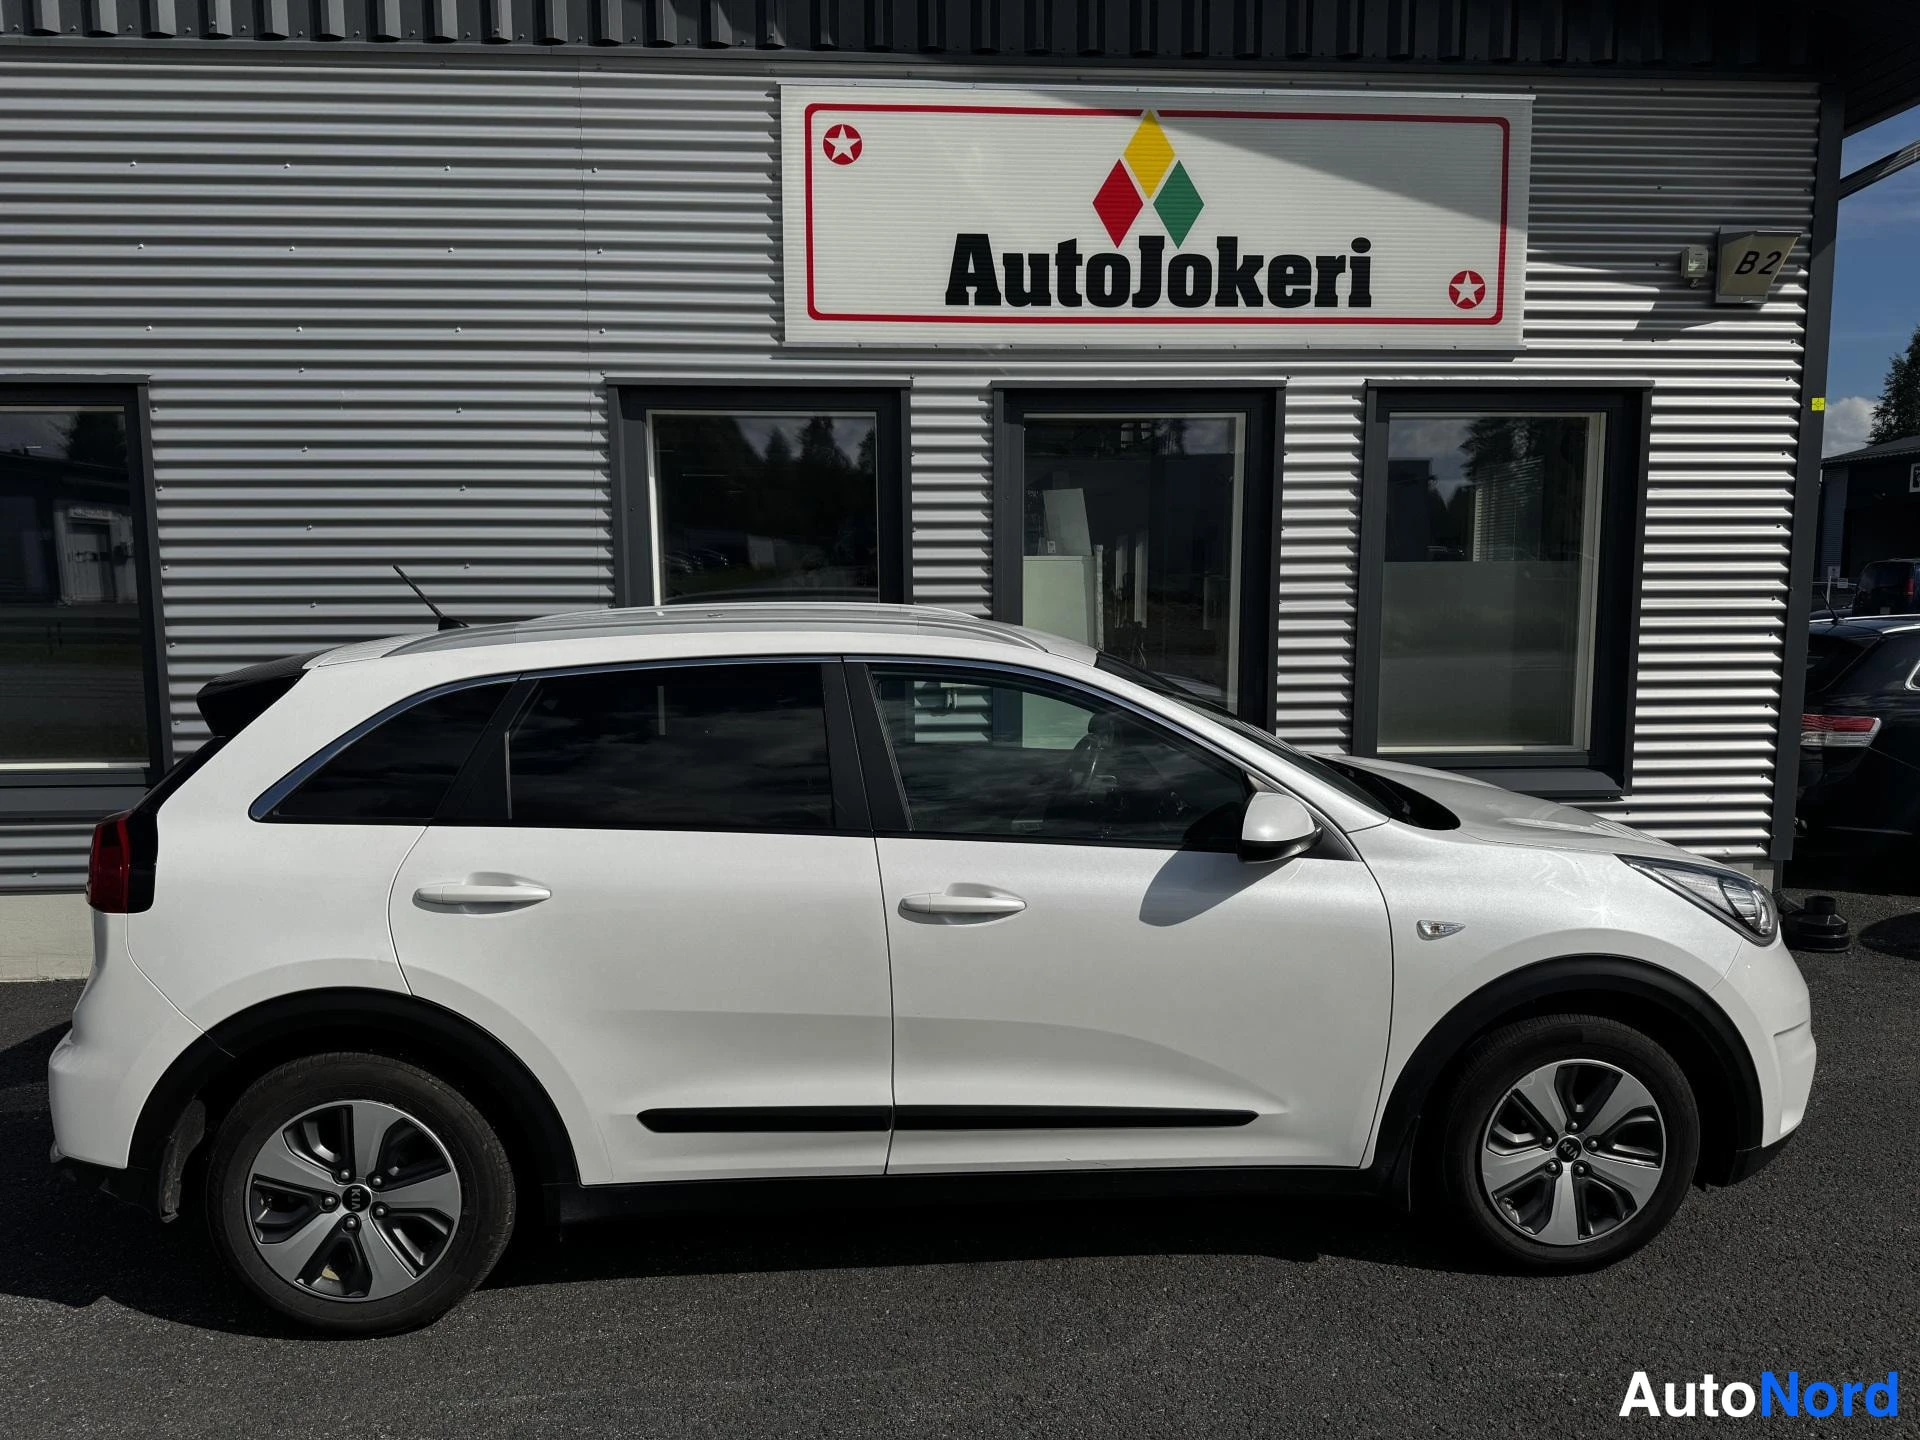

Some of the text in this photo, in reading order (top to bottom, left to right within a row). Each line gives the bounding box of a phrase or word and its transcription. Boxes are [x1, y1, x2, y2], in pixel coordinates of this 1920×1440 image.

[945, 233, 1372, 308] AutoJokeri
[1560, 1141, 1578, 1160] KIA
[351, 1188, 361, 1210] KIA
